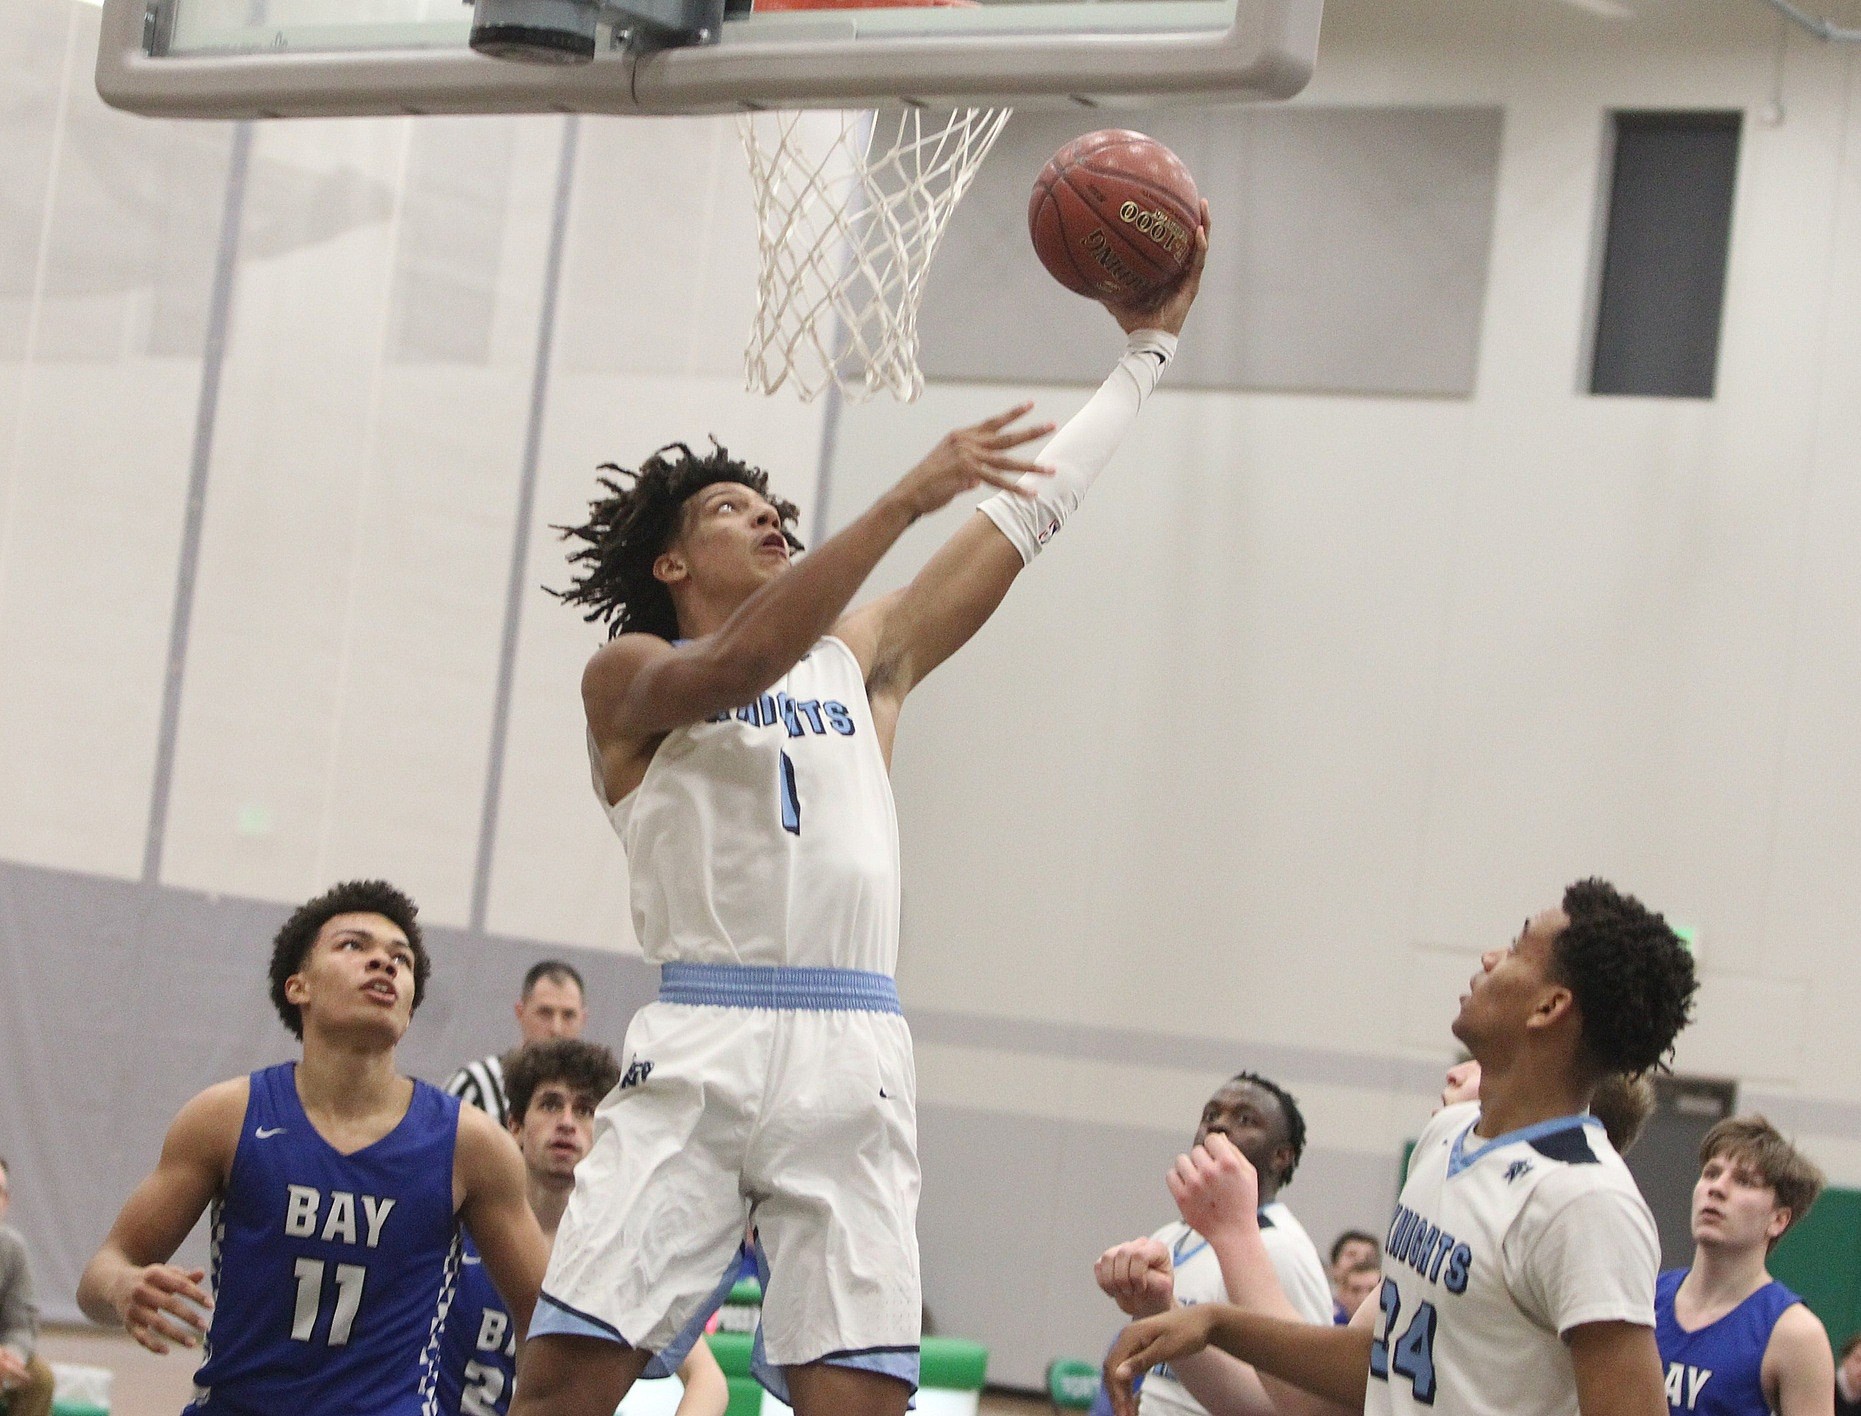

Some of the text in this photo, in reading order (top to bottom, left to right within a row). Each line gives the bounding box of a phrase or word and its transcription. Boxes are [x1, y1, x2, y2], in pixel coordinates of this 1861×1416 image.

[285, 1183, 396, 1249] BAY
[290, 1256, 367, 1347] 11
[1370, 1276, 1437, 1406] 24
[460, 1359, 517, 1416] 2
[1664, 1361, 1713, 1411] AY
